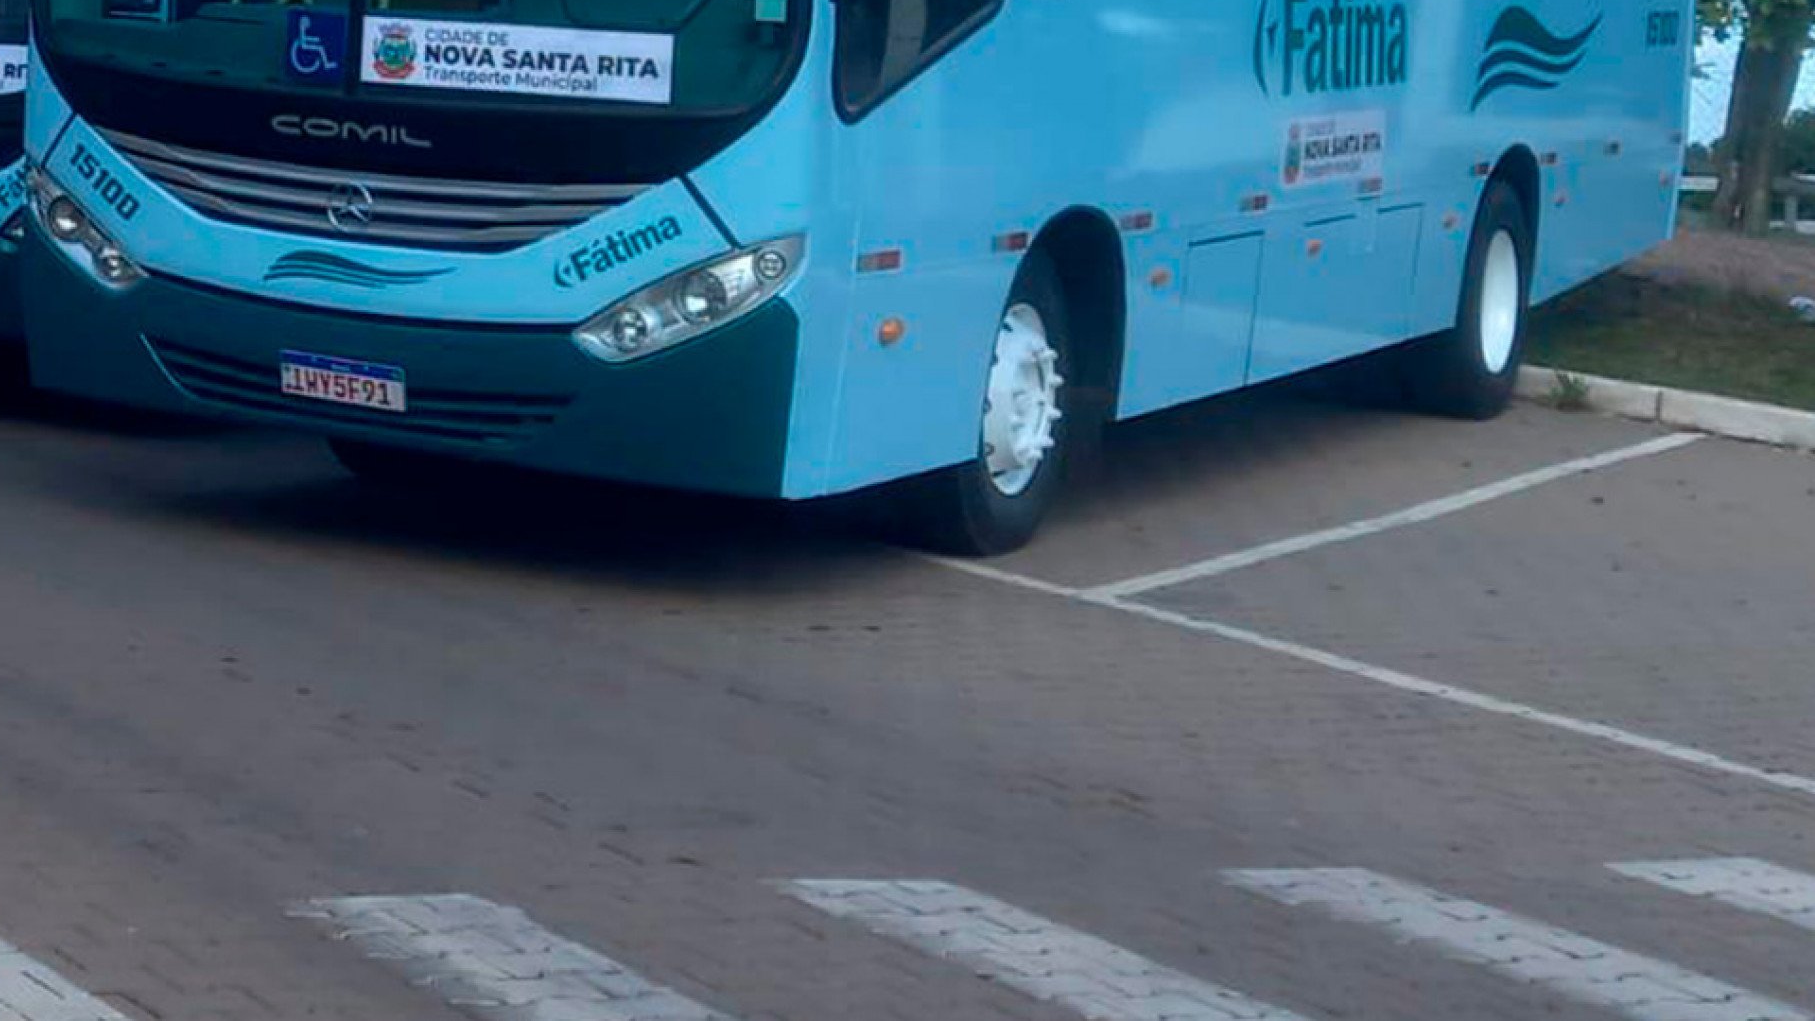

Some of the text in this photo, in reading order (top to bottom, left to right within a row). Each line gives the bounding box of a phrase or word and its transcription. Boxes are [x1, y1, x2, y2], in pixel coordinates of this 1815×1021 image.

[424, 29, 509, 46] CIDADE DE
[424, 44, 659, 79] NOVA SANTA RITA
[423, 65, 598, 93] Transporte Municipal
[271, 115, 432, 148] COMIL
[71, 143, 140, 220] 15100
[569, 216, 683, 282] Fátima
